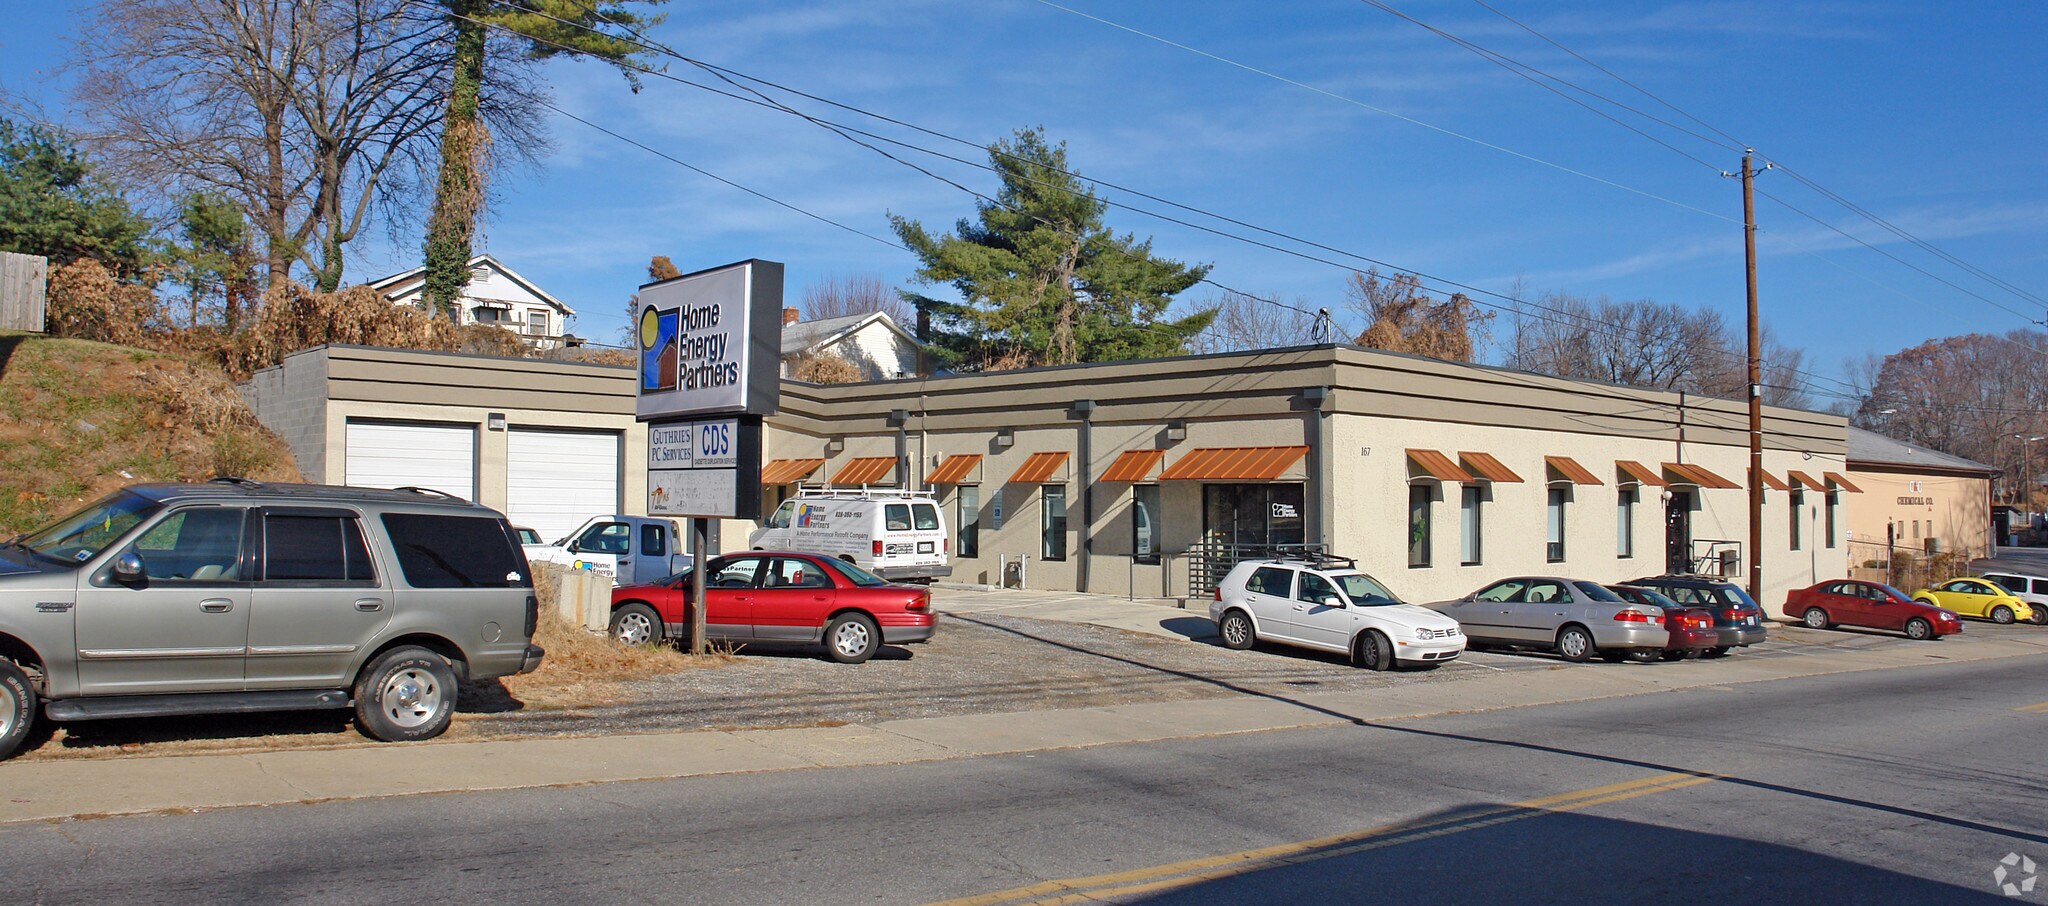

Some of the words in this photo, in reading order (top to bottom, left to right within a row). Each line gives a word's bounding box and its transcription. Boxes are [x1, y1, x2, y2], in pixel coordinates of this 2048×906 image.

[681, 303, 721, 331] Home
[680, 332, 729, 362] Energy
[679, 360, 739, 390] Partners
[653, 429, 690, 444] GUTHRIE'S
[702, 423, 729, 455] CDS
[652, 447, 661, 461] PC
[663, 447, 691, 461] SERVICES
[1361, 447, 1371, 456] 167
[1897, 497, 1924, 505] CHEMICAL
[850, 532, 868, 540] Company
[7, 676, 29, 737] GENERAL
